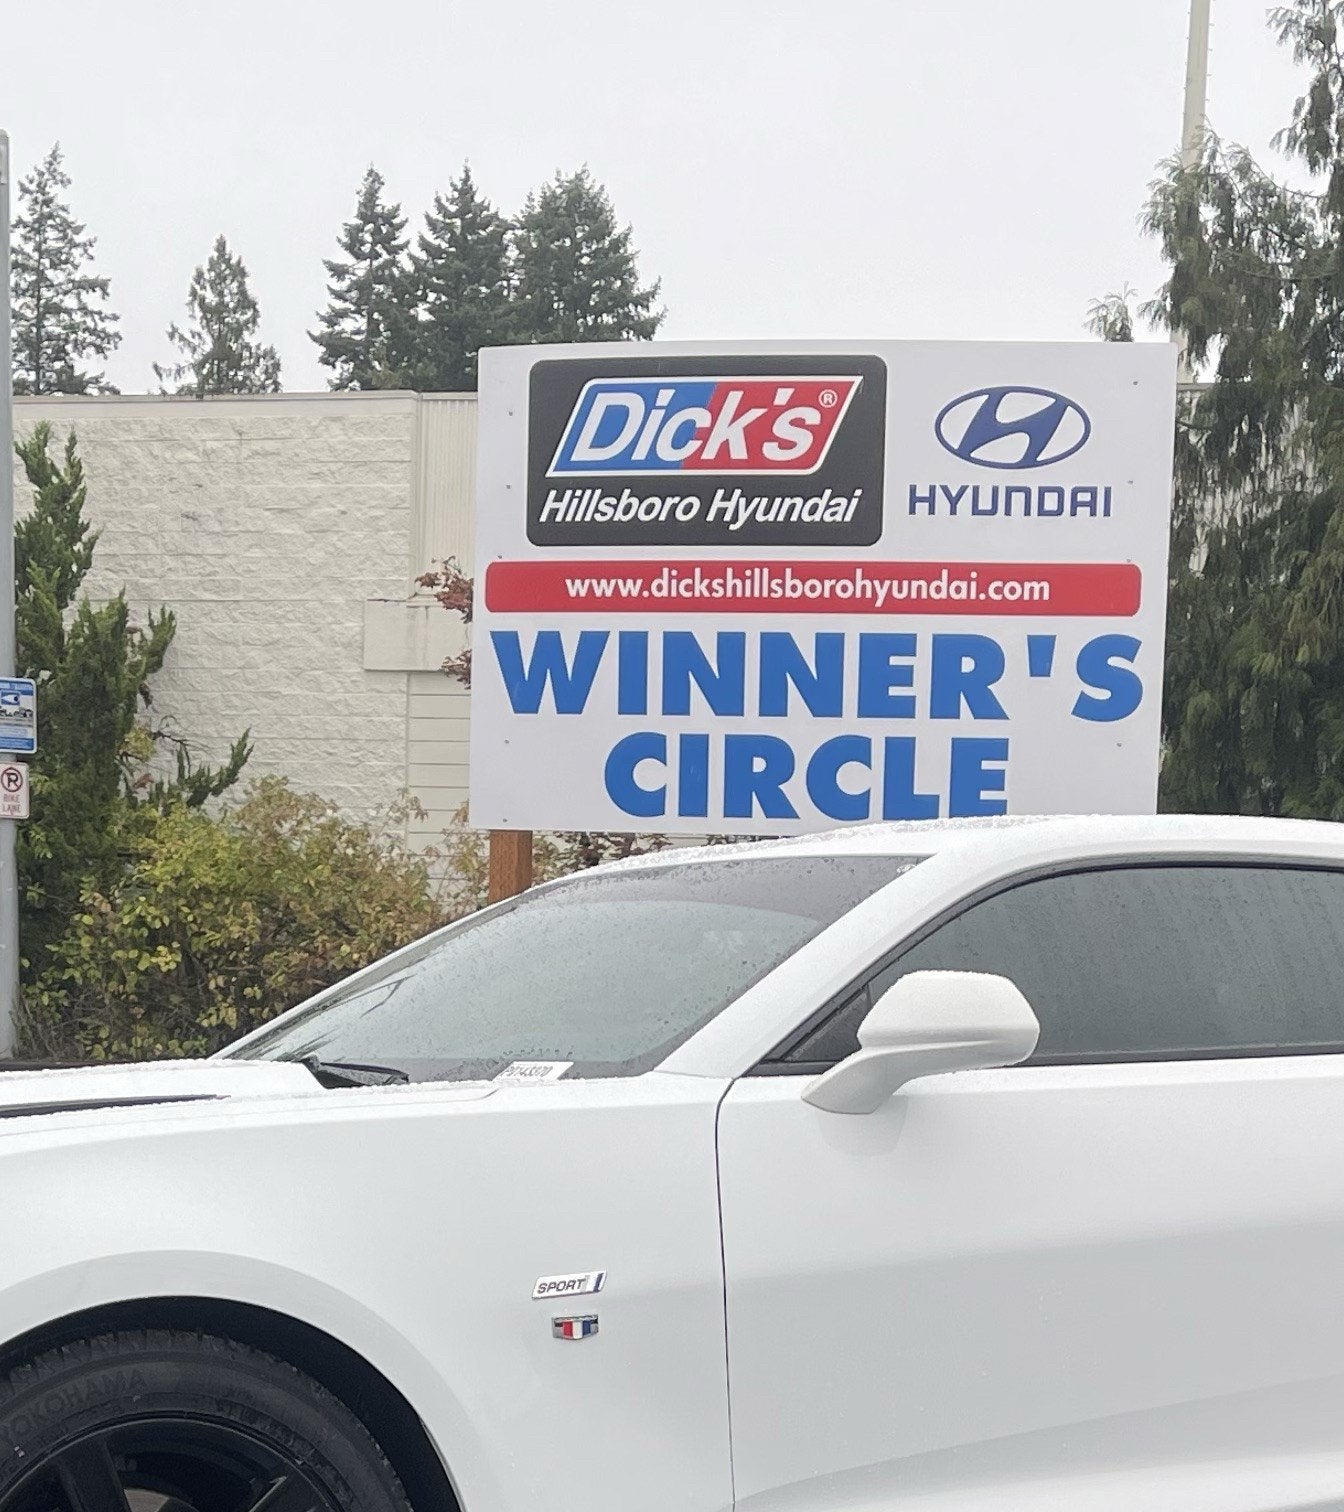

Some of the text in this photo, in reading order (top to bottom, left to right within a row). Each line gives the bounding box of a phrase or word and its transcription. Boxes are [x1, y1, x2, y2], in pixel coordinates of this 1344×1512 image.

[571, 388, 821, 462] Dick's
[539, 488, 863, 531] Hillsboro Hyundai
[909, 484, 1112, 517] HYUNDAI
[565, 566, 1051, 608] www.dickshillsborohyundai.com
[491, 630, 1143, 722] WINNER'S
[604, 731, 1010, 820] CIRCLE
[536, 1278, 587, 1295] SPORT
